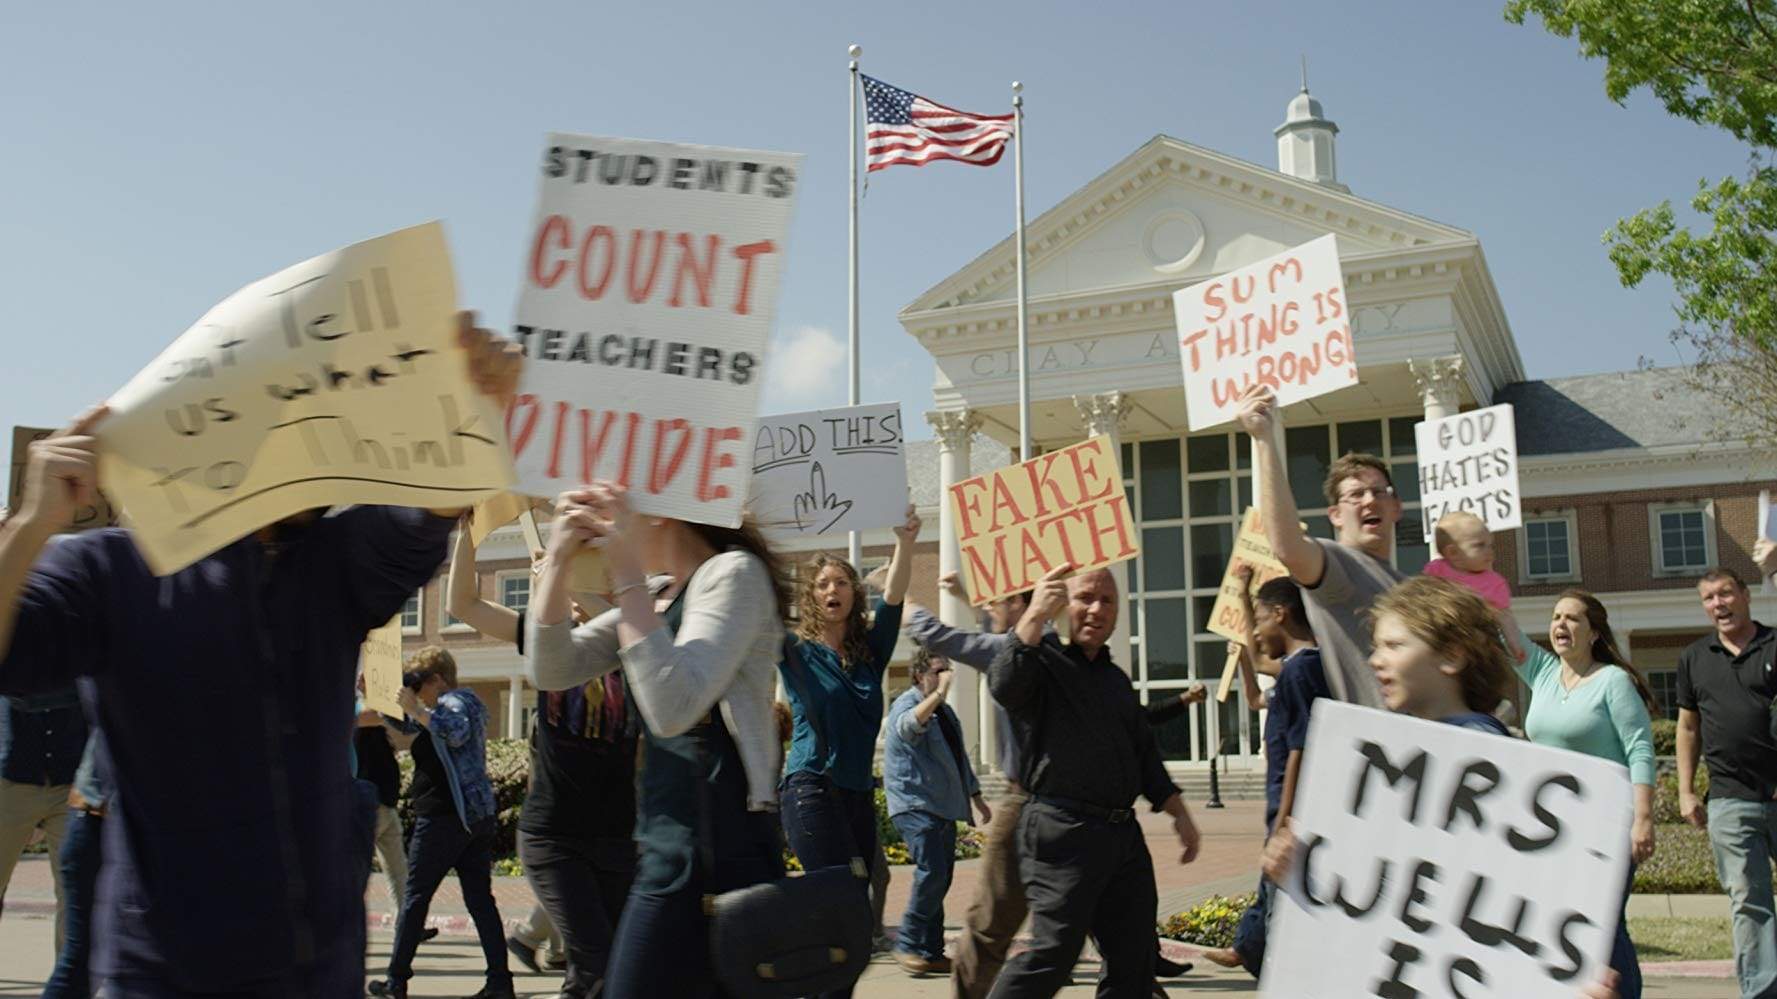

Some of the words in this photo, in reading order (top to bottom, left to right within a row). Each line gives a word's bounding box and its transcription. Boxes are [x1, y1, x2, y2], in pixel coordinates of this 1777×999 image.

[543, 145, 798, 199] STUDENTS
[529, 213, 777, 316] COUNT
[1203, 257, 1303, 323] SUM
[512, 324, 760, 386] TEACHERS
[970, 340, 1100, 377] CLAY
[1182, 301, 1299, 374] THING
[1313, 287, 1342, 326] IS
[1211, 323, 1358, 409] WRONG!
[505, 394, 742, 503] DIVIDE
[752, 423, 816, 472] ADD
[823, 408, 904, 448] THIS!
[1437, 411, 1496, 451] GOD
[948, 440, 1115, 542] FAKE
[1418, 447, 1510, 495] HATES
[961, 495, 1138, 604] MATH
[1300, 834, 1599, 982] WELLS
